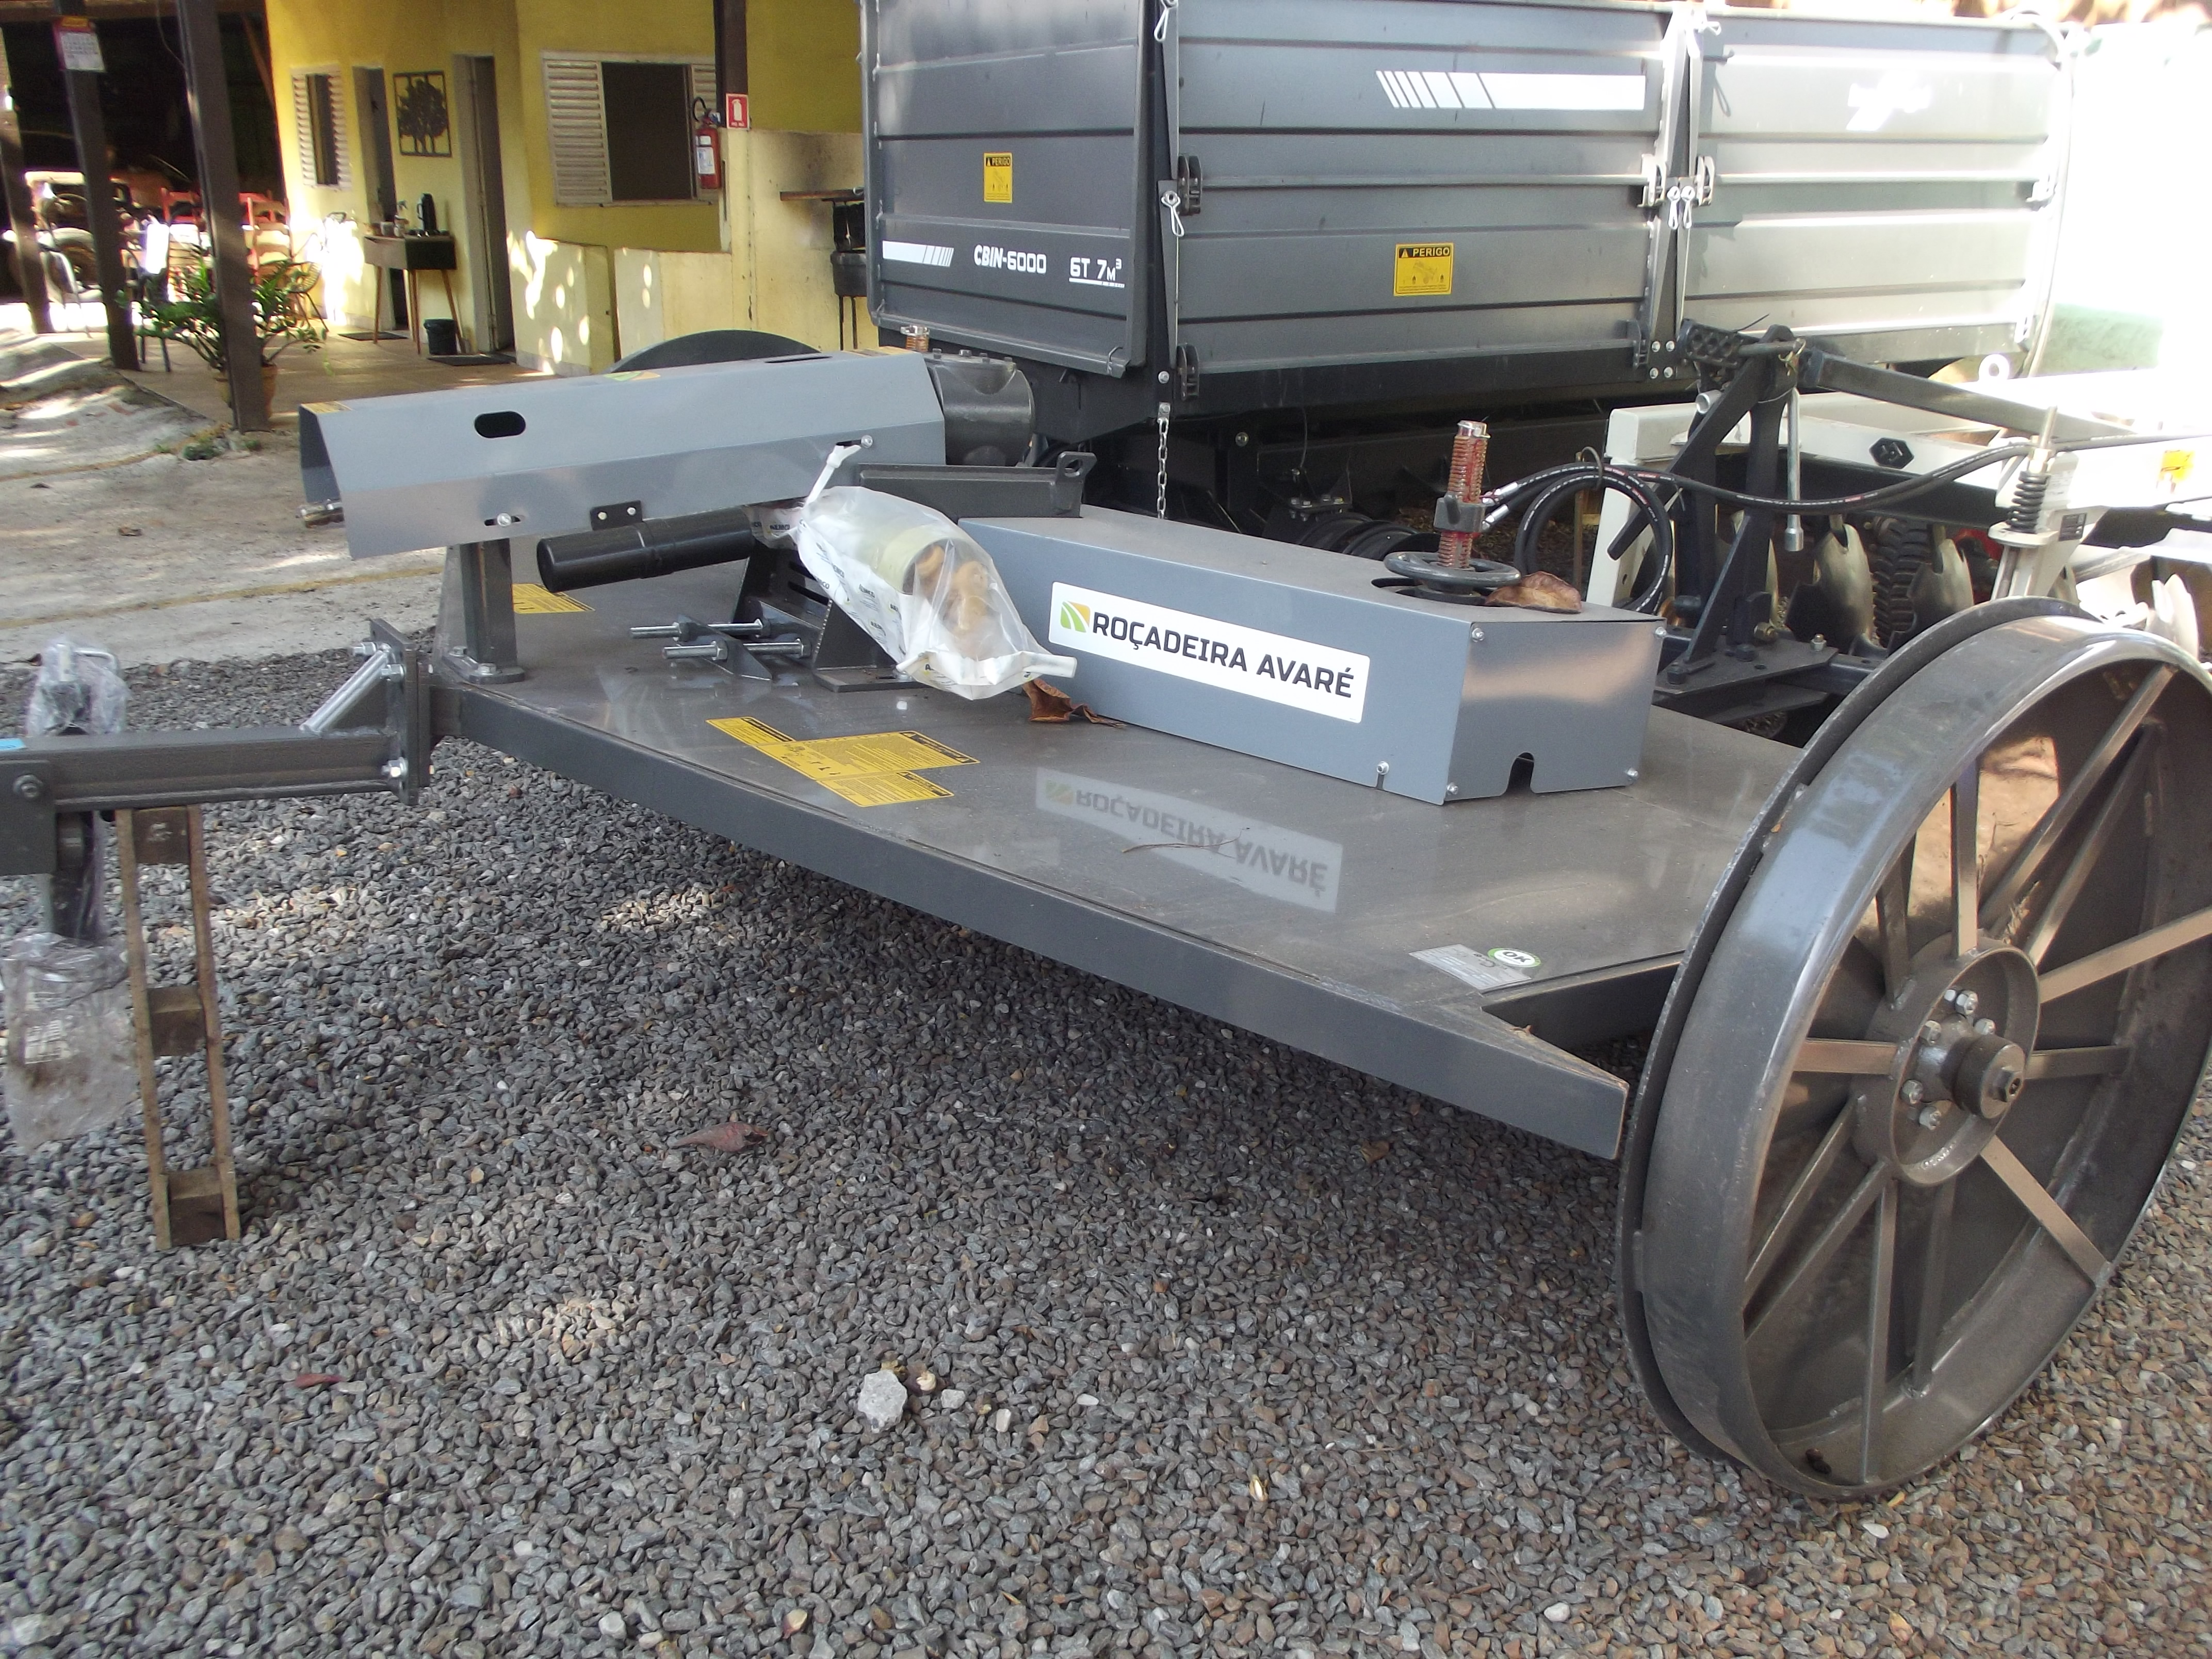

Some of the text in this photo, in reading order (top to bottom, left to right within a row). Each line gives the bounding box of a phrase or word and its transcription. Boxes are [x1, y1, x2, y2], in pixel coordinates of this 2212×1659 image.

[992, 157, 1010, 166] PERIGO
[1413, 247, 1450, 257] PERIGO
[974, 245, 1047, 273] CBIN-6000
[1070, 257, 1091, 278] 6T
[1093, 612, 1354, 698] ROÇADEIRA AVARÉ
[1502, 951, 1531, 963] OK
